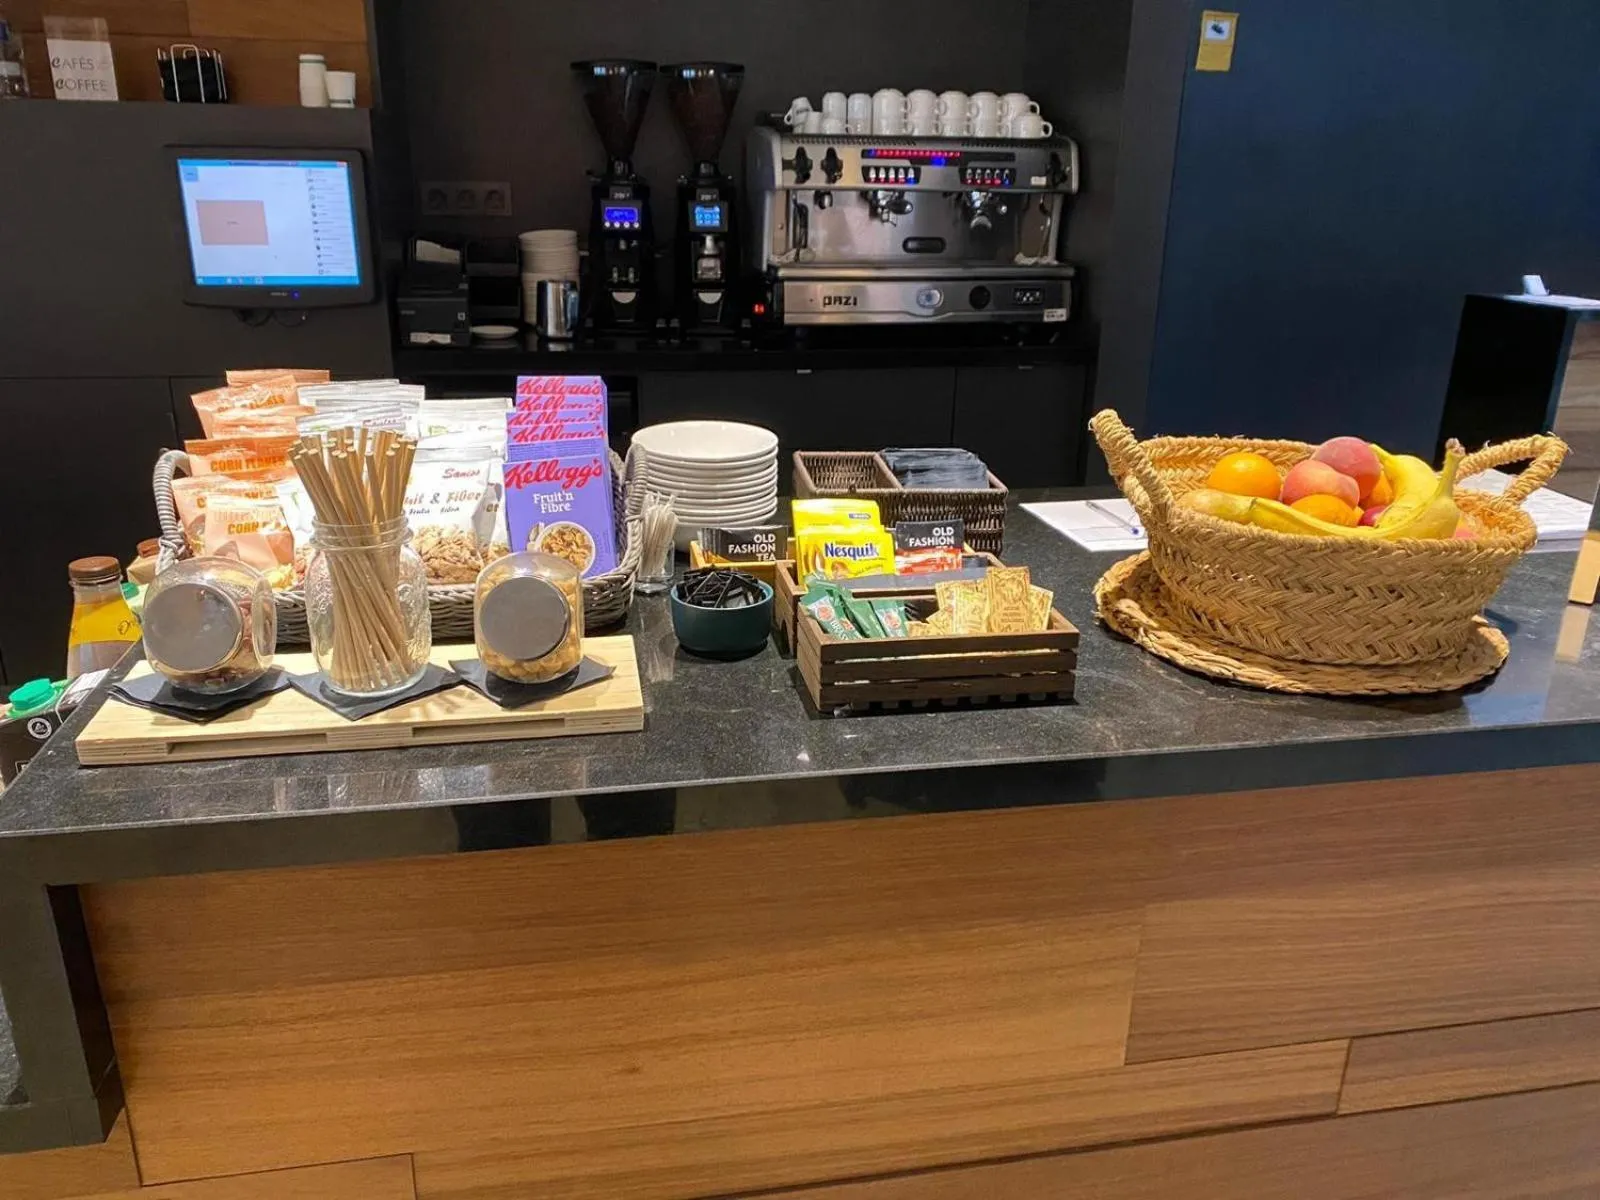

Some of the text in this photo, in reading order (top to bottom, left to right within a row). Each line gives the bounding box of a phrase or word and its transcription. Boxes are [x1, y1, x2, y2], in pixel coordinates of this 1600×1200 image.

[55, 79, 108, 91] COFFEE
[210, 460, 242, 472] CORN
[504, 458, 603, 489] Kellogg's
[533, 491, 574, 505] Fruit'n
[541, 503, 573, 513] Fibre
[227, 521, 259, 535] CORN
[932, 527, 954, 536] OLD
[753, 534, 776, 544] OLD
[908, 536, 954, 547] FASHION
[728, 543, 776, 554] FASHION
[824, 542, 880, 561] Nesquik
[756, 553, 776, 561] TEA
